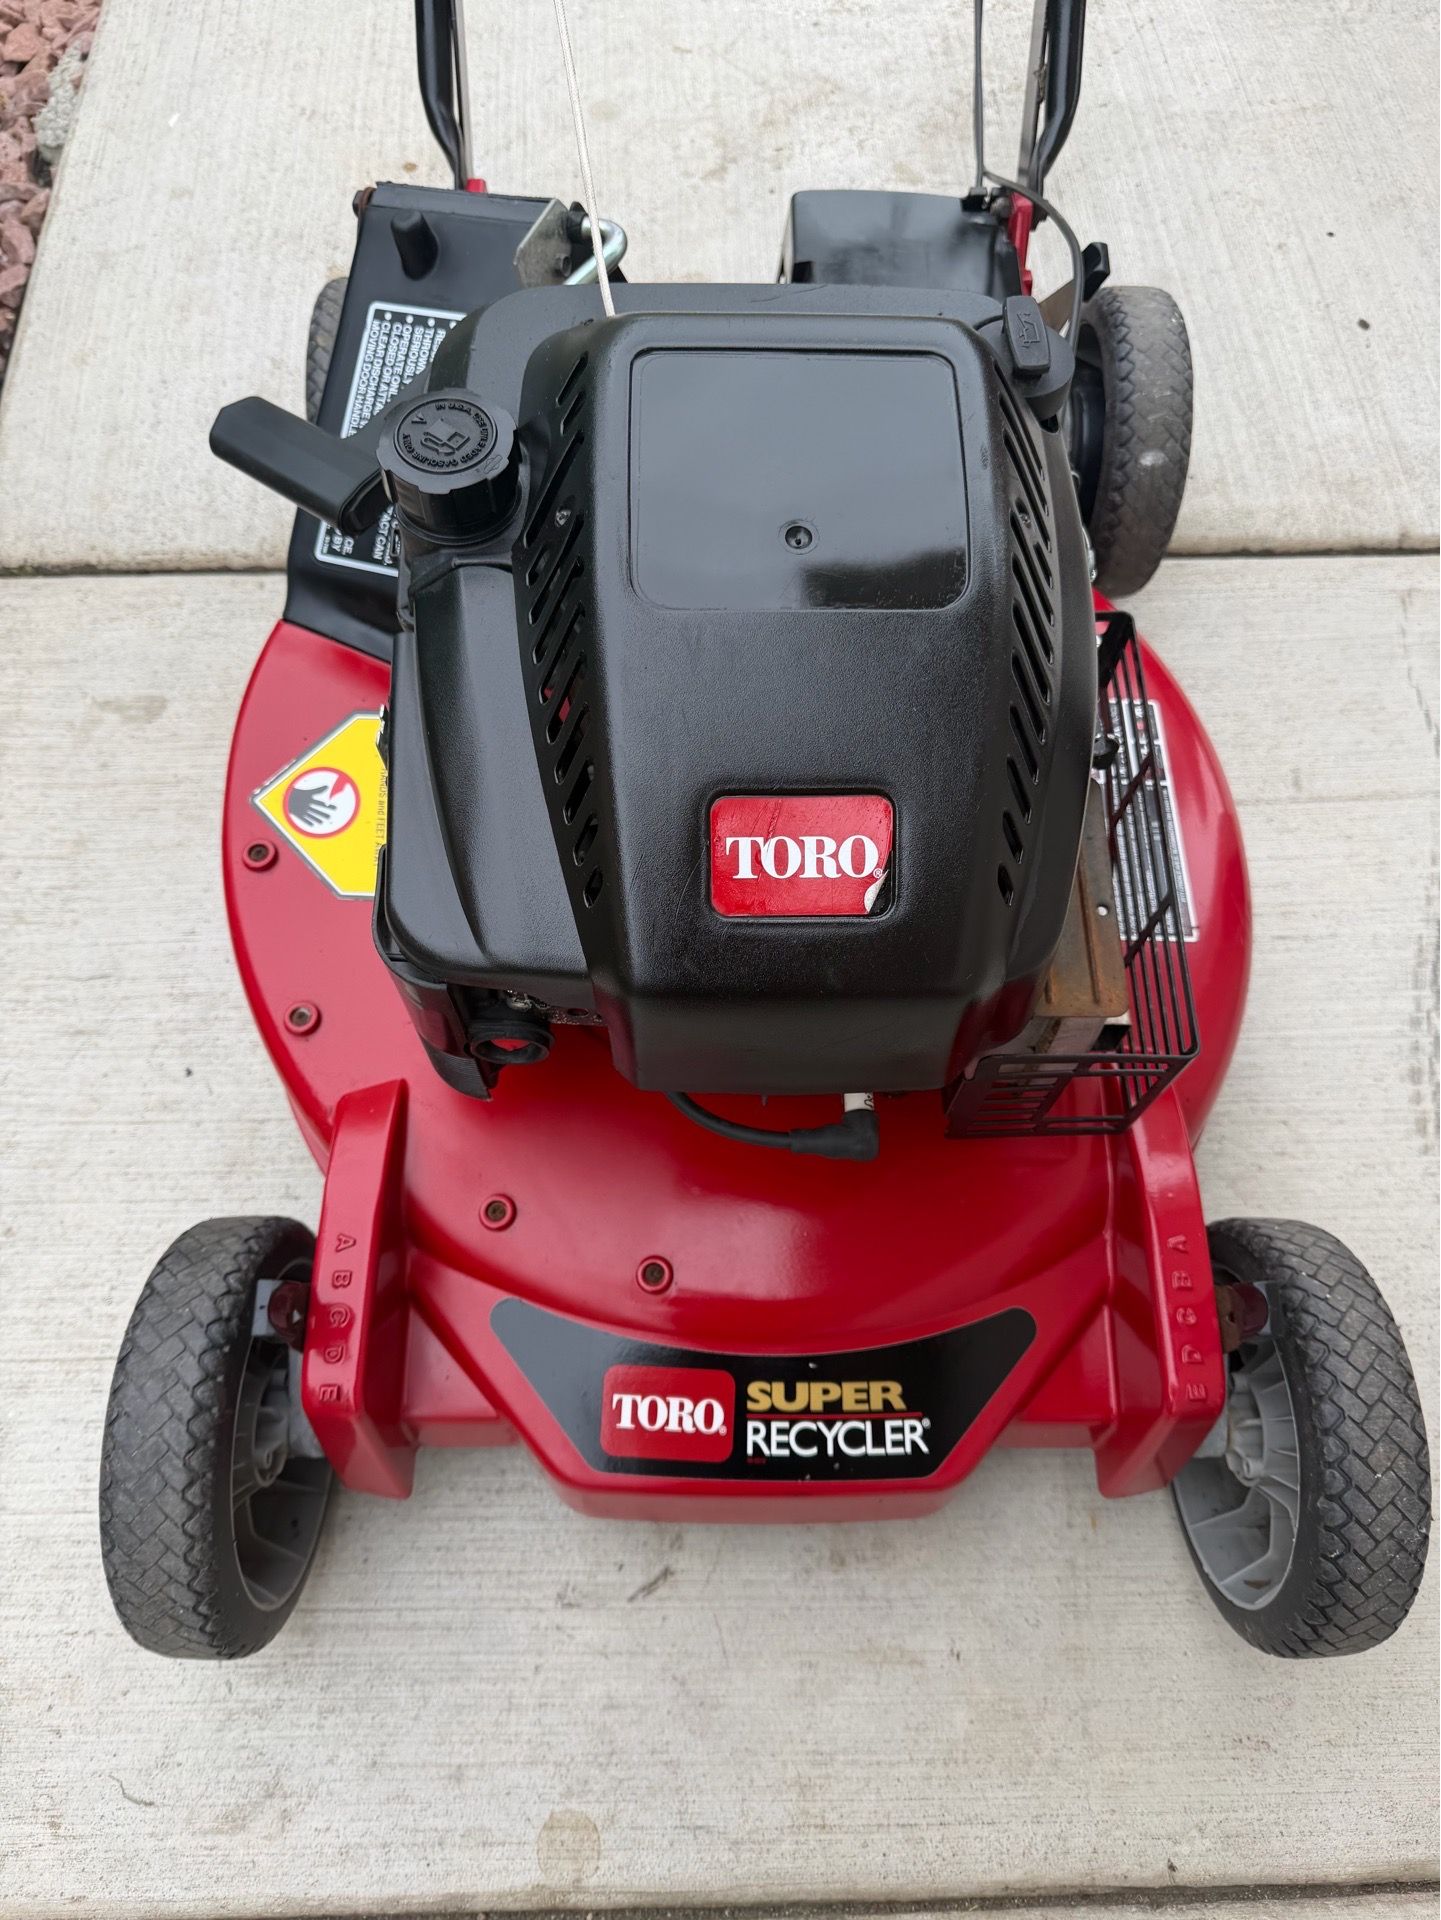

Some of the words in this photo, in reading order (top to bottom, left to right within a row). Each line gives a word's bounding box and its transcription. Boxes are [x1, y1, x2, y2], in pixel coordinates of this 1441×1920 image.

[364, 319, 381, 362] MOVING
[376, 321, 391, 359] CLEAR
[385, 322, 402, 366] CLOSED
[393, 324, 412, 375] OPERATE
[357, 363, 372, 397] DOOR
[362, 359, 384, 420] DISCHARGE
[379, 366, 392, 383] OR
[387, 375, 400, 402] ONL
[373, 383, 388, 415] ATTA
[412, 452, 458, 467] GASOLINE
[373, 534, 386, 560] CAN
[376, 818, 386, 840] FEET
[725, 835, 879, 879] TORO
[336, 1233, 356, 1252] A
[332, 1270, 353, 1289] B
[330, 1305, 350, 1328] C
[324, 1344, 345, 1364] D
[319, 1383, 341, 1402] E
[746, 1381, 907, 1413] SUPER
[612, 1393, 725, 1435] TORO
[746, 1419, 930, 1457] RECYCLER
